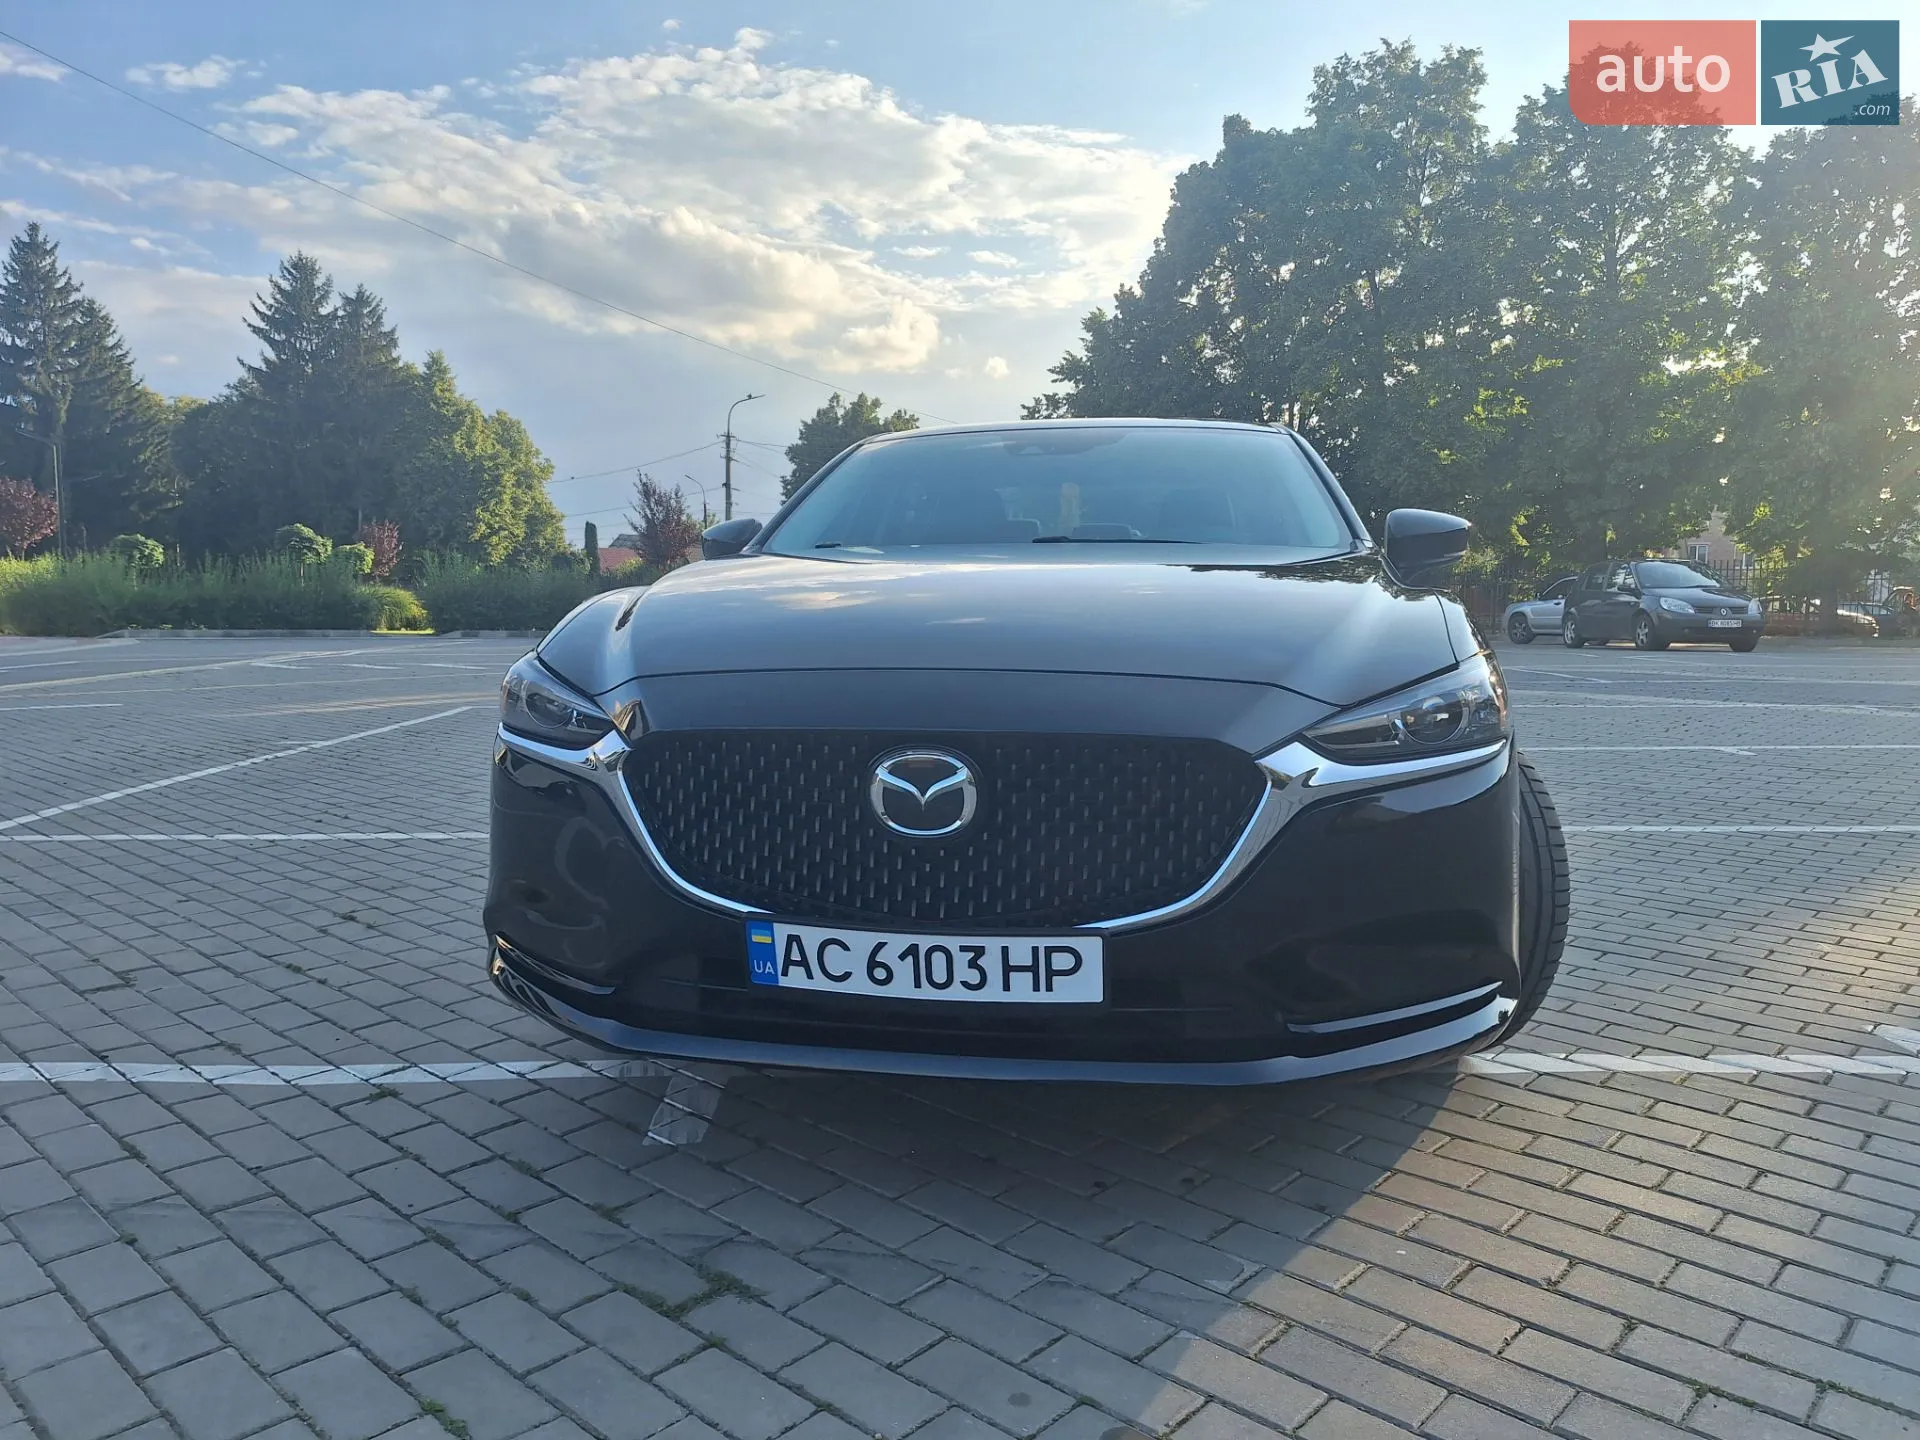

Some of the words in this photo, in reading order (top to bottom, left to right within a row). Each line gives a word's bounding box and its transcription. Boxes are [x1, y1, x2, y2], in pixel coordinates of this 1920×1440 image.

[753, 960, 775, 975] UA
[781, 934, 853, 983] AC
[866, 941, 987, 991] 6103
[1001, 945, 1083, 992] HP
